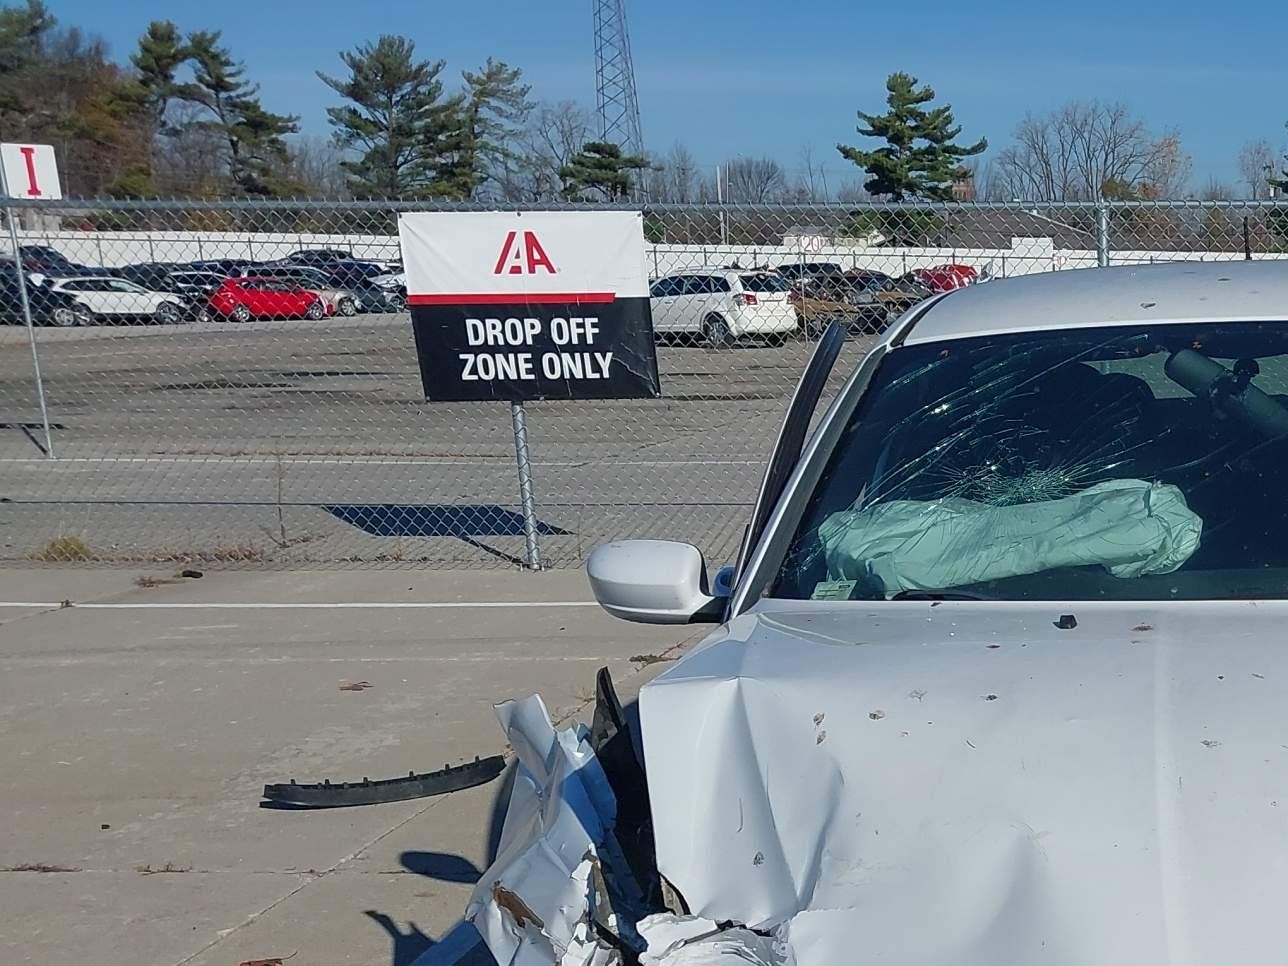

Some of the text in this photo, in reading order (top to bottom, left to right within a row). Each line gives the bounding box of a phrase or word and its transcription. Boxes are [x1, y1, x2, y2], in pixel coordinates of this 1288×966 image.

[465, 317, 599, 346] DROP OFF
[458, 352, 613, 380] ZONE ONLY
